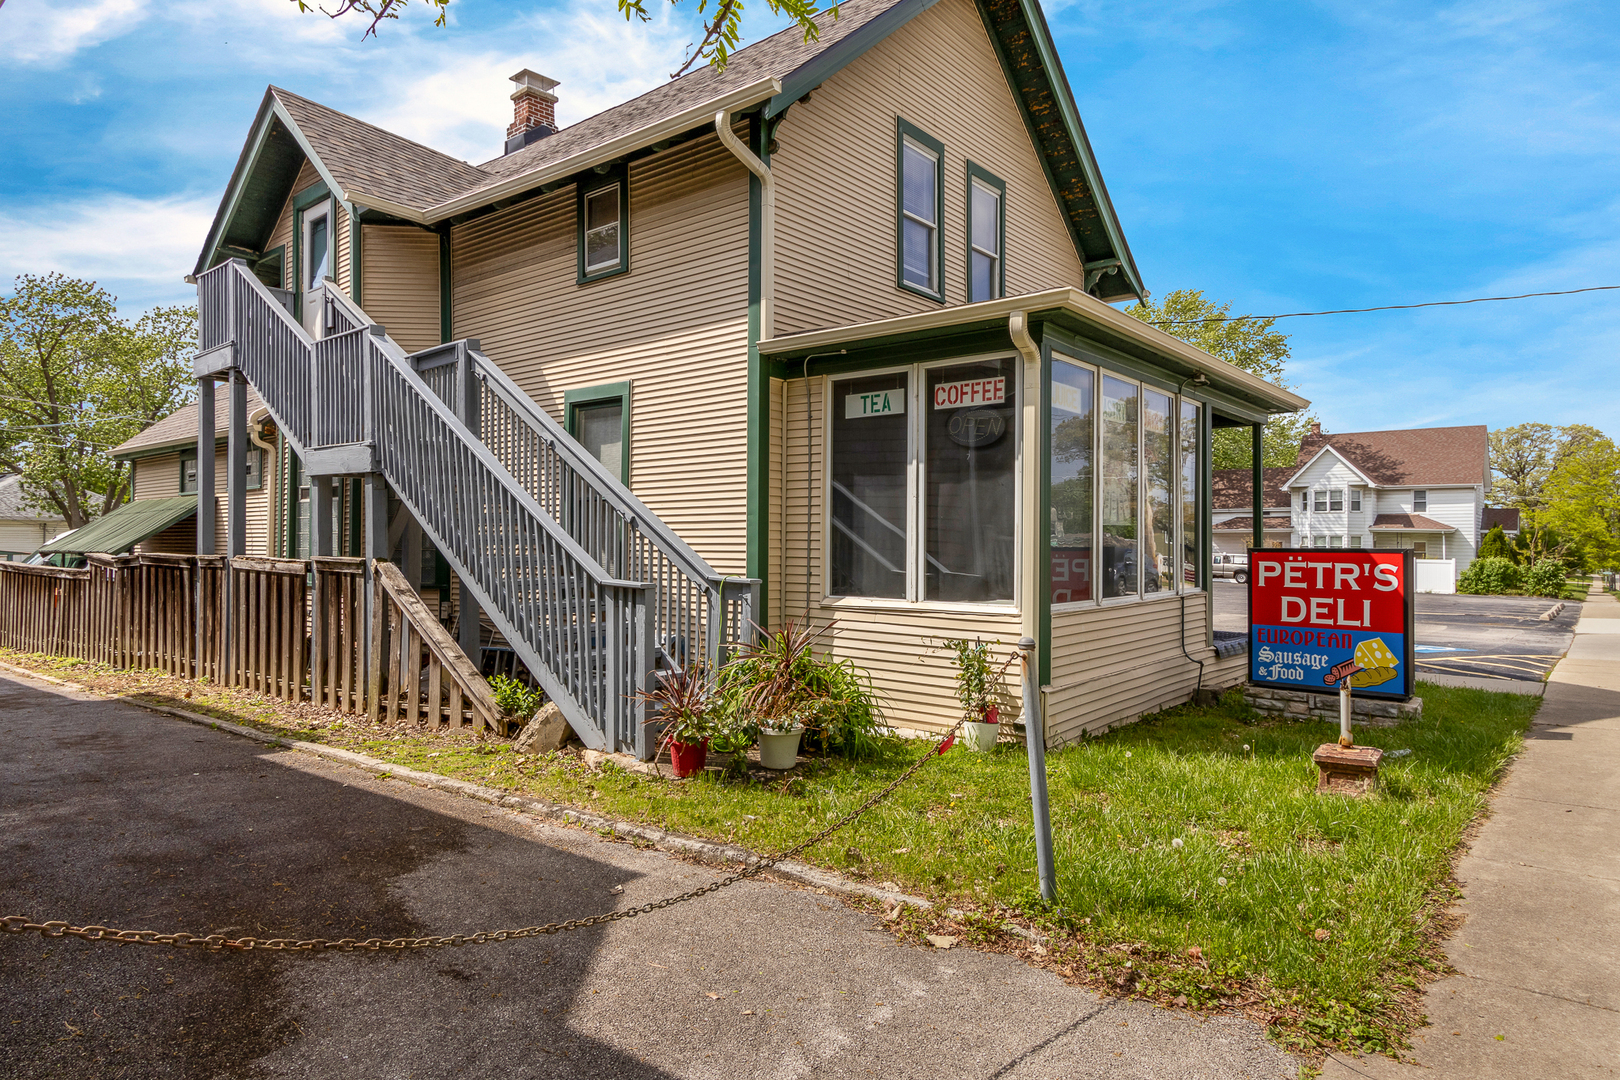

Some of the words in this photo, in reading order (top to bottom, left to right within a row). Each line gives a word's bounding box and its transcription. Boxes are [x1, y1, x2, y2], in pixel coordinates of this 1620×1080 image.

[860, 393, 891, 414] TEA
[934, 379, 1004, 406] COFFEE
[949, 416, 1003, 436] OPEN
[1257, 556, 1399, 592] PËTR'S
[1280, 596, 1371, 627] DELI
[1256, 628, 1353, 649] EUROPEAN
[1258, 646, 1329, 670] Sausage
[1258, 666, 1268, 676] &
[1266, 663, 1304, 681] Food
